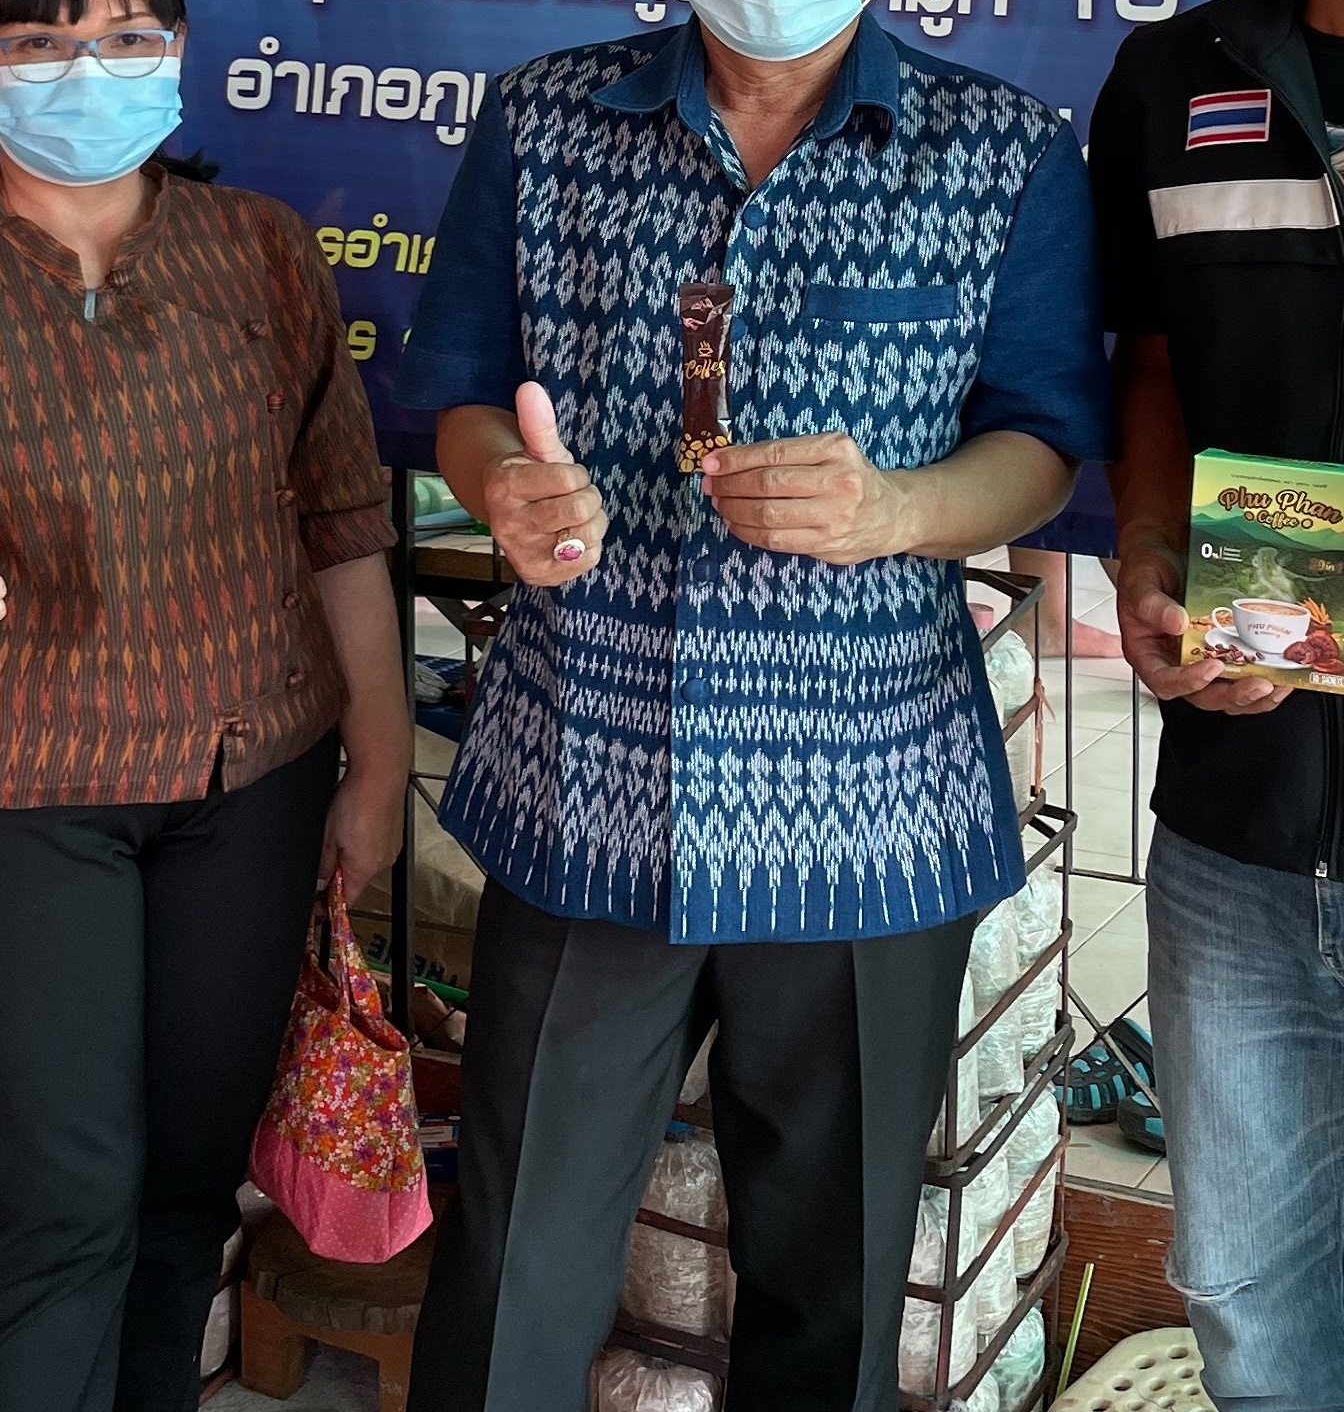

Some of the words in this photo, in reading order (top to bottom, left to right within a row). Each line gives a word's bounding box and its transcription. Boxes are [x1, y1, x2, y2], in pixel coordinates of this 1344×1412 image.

[1218, 485, 1273, 511] Phu
[1276, 489, 1344, 524] Phan
[1257, 509, 1300, 529] Coffee
